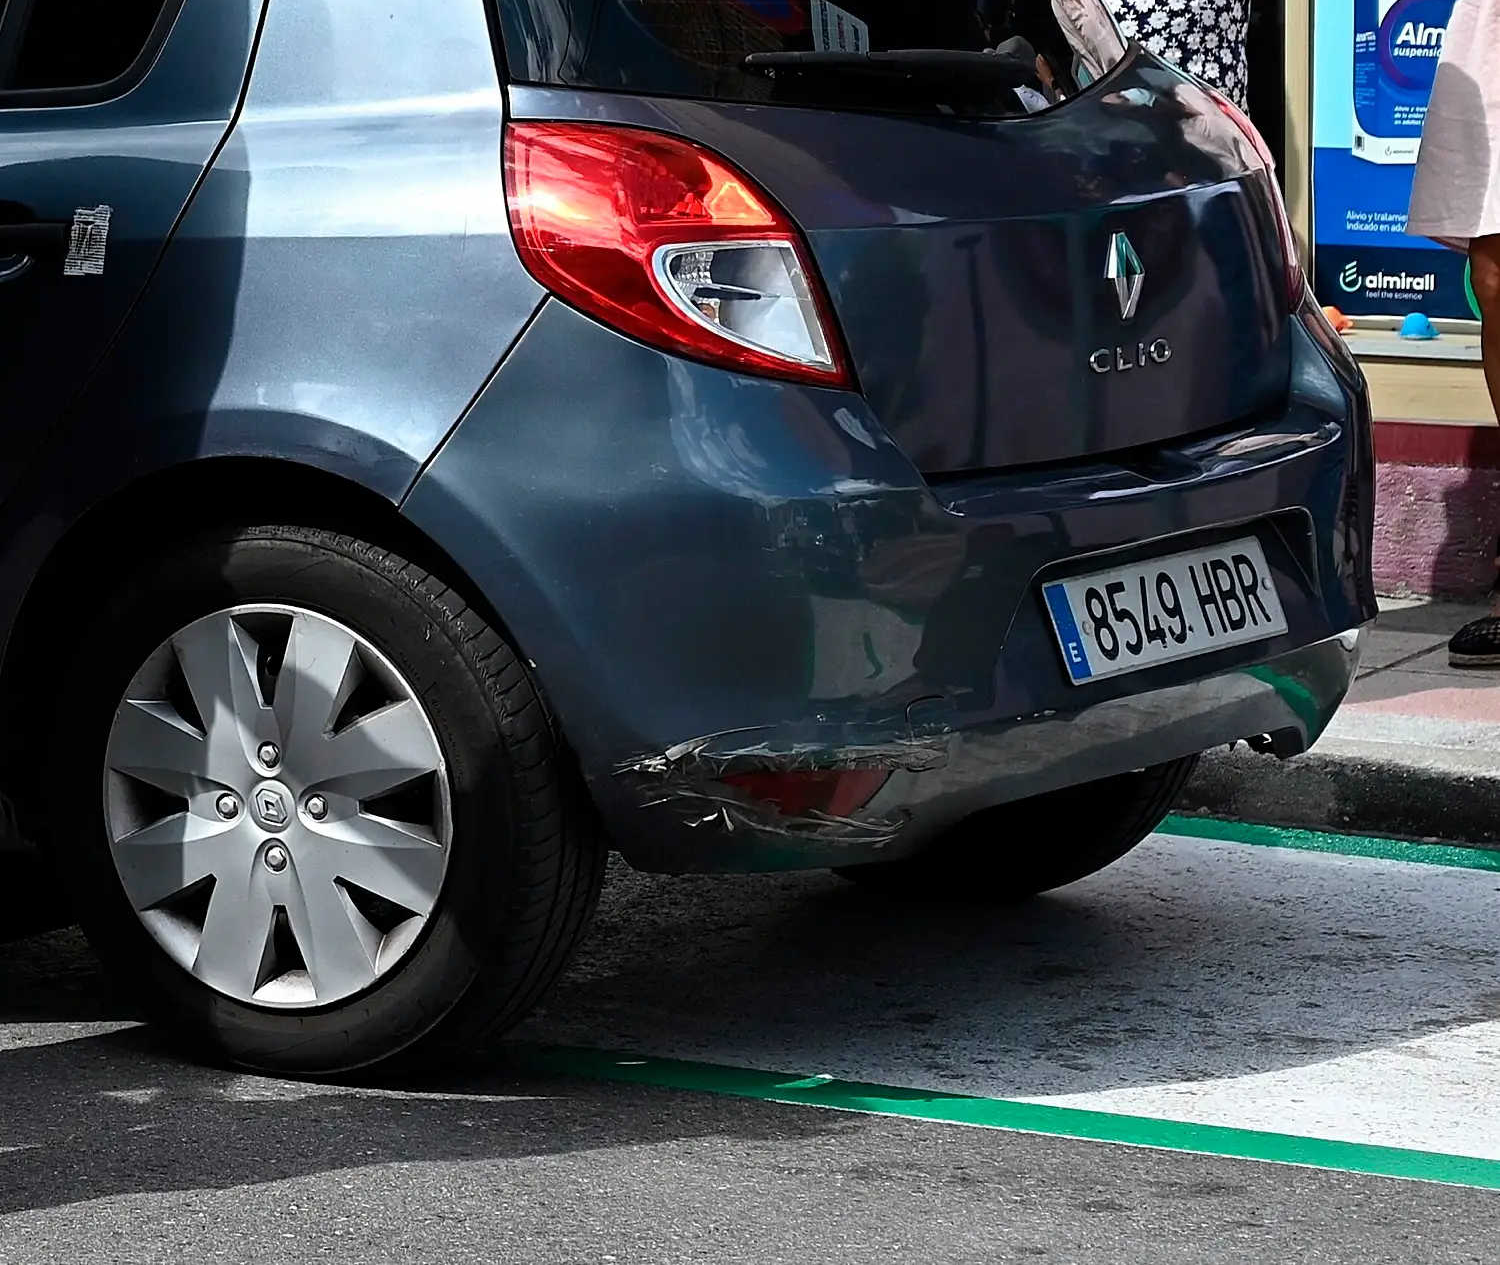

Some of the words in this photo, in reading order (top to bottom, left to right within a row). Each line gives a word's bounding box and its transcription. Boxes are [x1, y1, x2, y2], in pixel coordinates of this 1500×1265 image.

[1346, 210, 1367, 220] Alivio
[1368, 213, 1373, 223] y
[1346, 220, 1378, 231] Indicado
[1379, 223, 1390, 232] en
[1365, 271, 1435, 291] almirall
[1365, 290, 1381, 299] feel
[1381, 290, 1393, 299] the
[1394, 291, 1423, 300] science
[1089, 338, 1172, 374] CLIO
[1067, 641, 1082, 664] E
[1084, 572, 1190, 662] 8549
[1188, 553, 1273, 638] HBR
